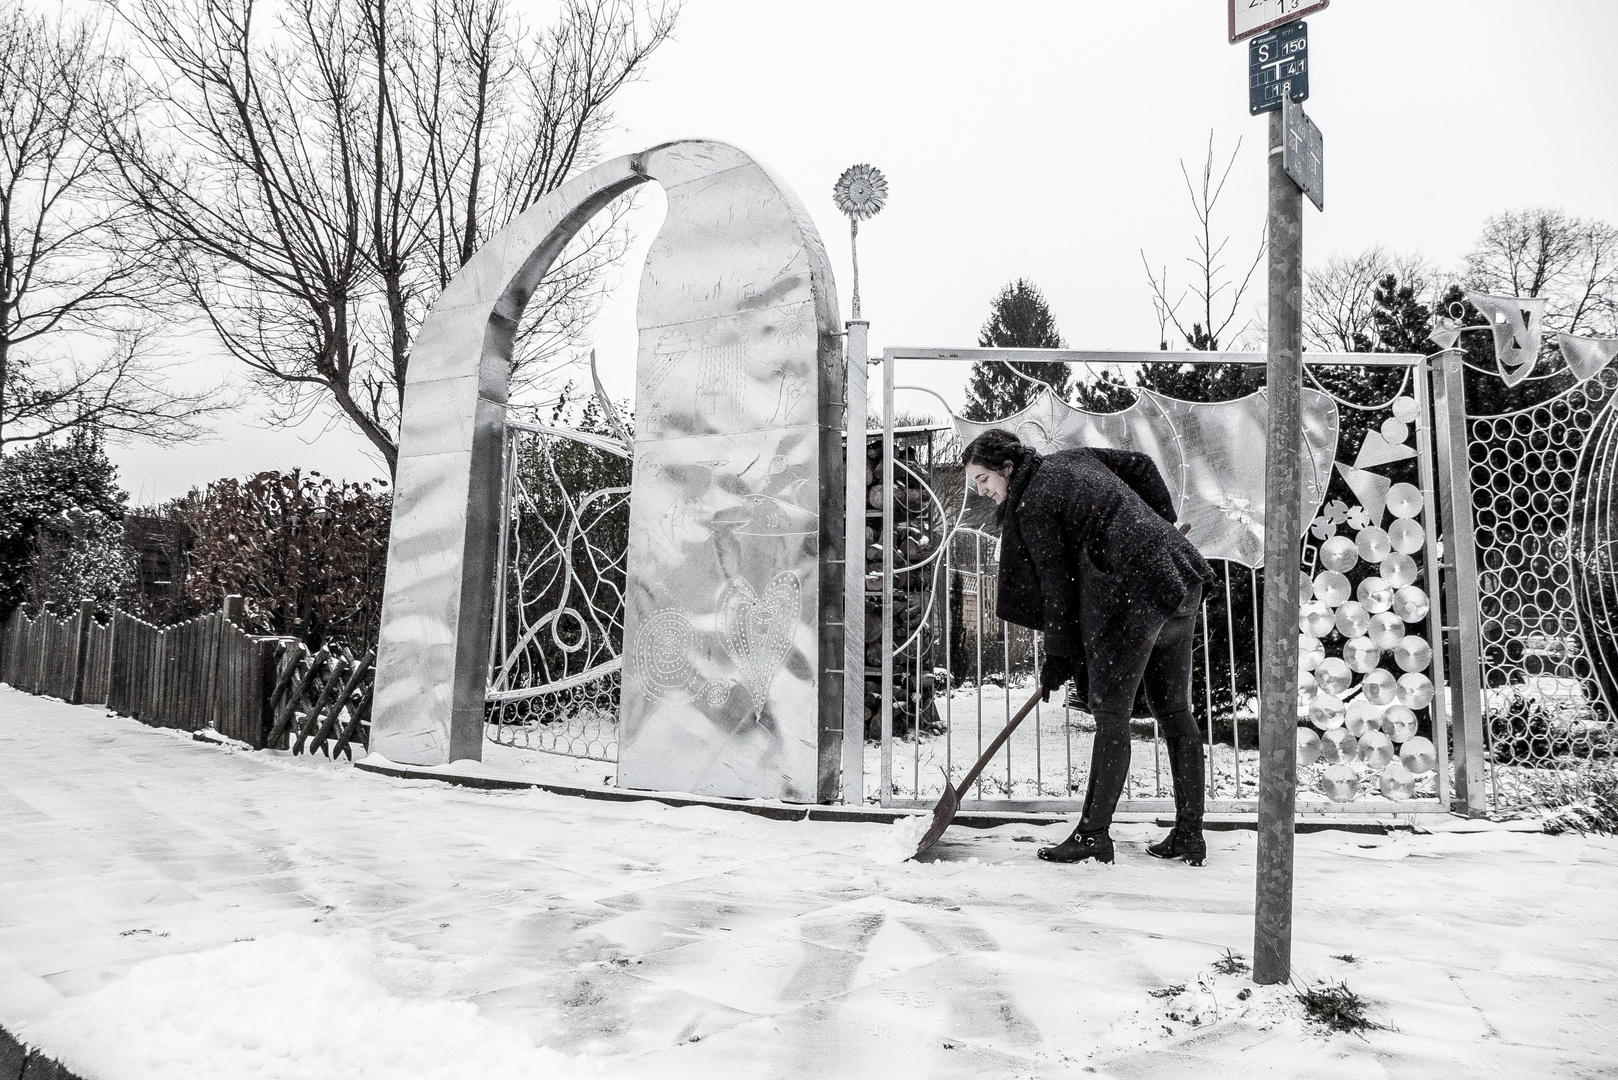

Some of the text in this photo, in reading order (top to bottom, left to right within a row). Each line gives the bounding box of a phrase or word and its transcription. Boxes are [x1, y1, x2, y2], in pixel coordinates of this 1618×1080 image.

[1274, 13, 1297, 25] Minden
[1258, 34, 1278, 44] Wasser
[1258, 44, 1269, 63] S
[1283, 38, 1306, 55] 150
